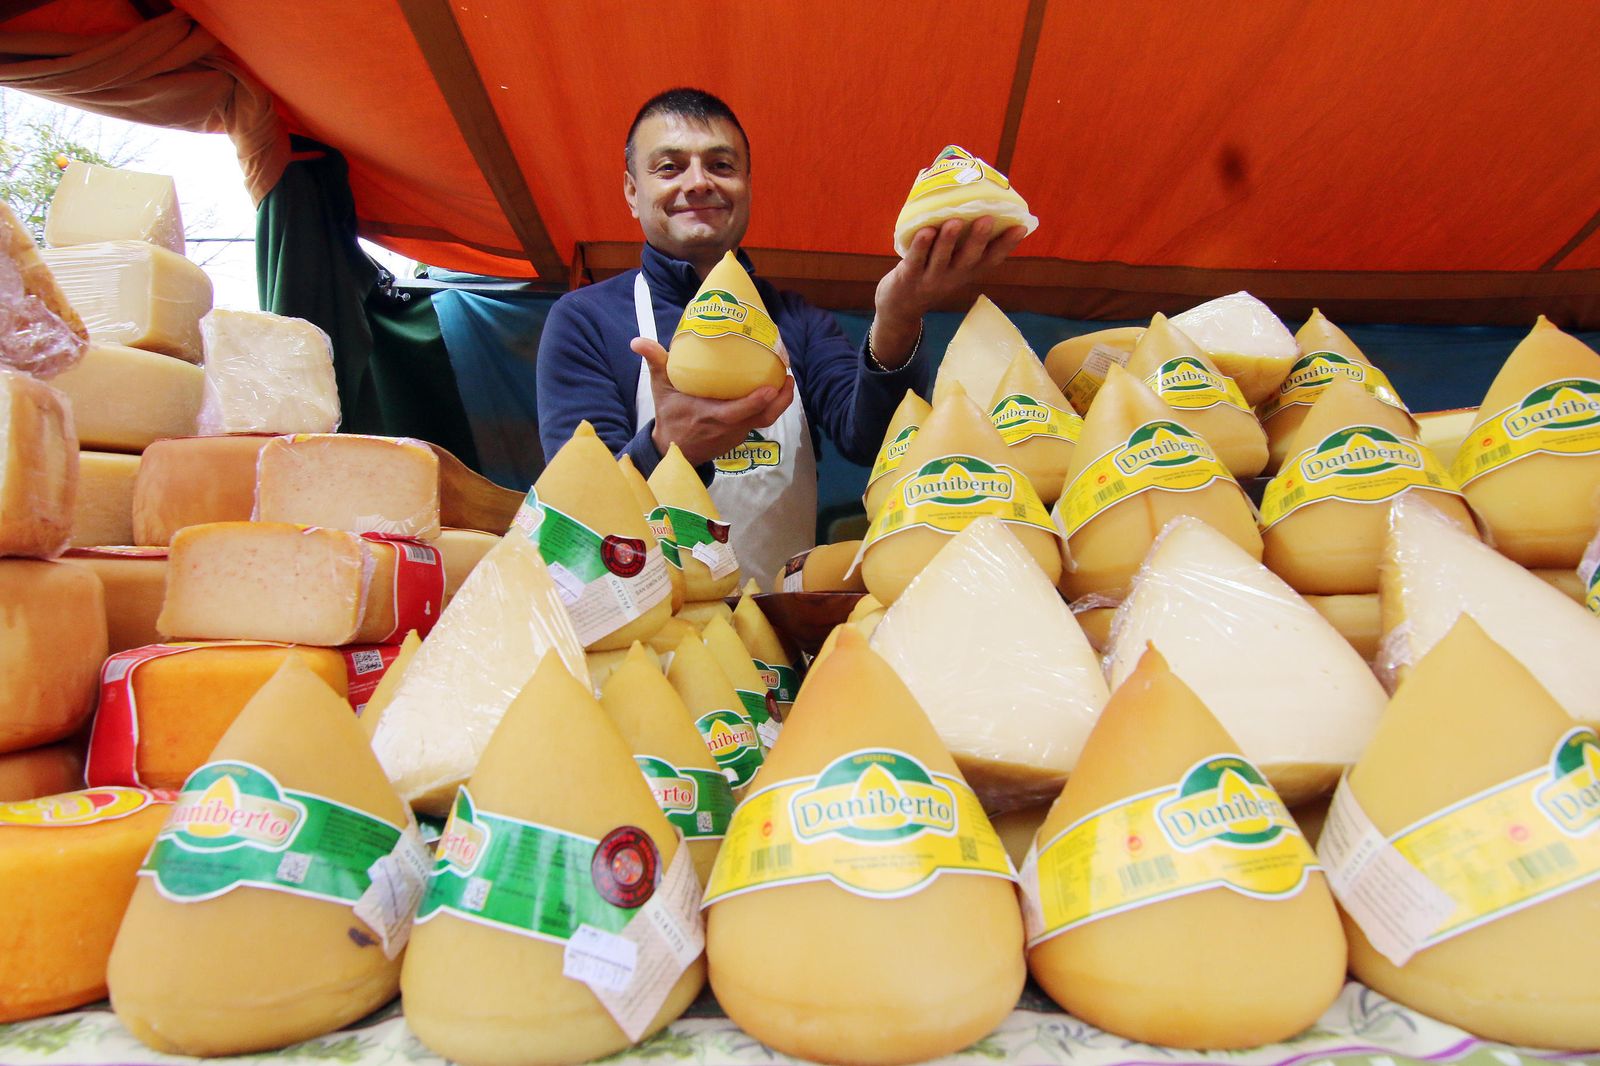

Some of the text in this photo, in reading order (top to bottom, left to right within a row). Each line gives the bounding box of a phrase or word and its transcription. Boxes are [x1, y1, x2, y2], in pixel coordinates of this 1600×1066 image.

[689, 303, 744, 319] Daniberto
[1308, 446, 1417, 475] Daniberto
[909, 477, 1009, 499] Daniberto
[799, 788, 951, 829] Daniberto
[1168, 792, 1282, 837] Daniber
